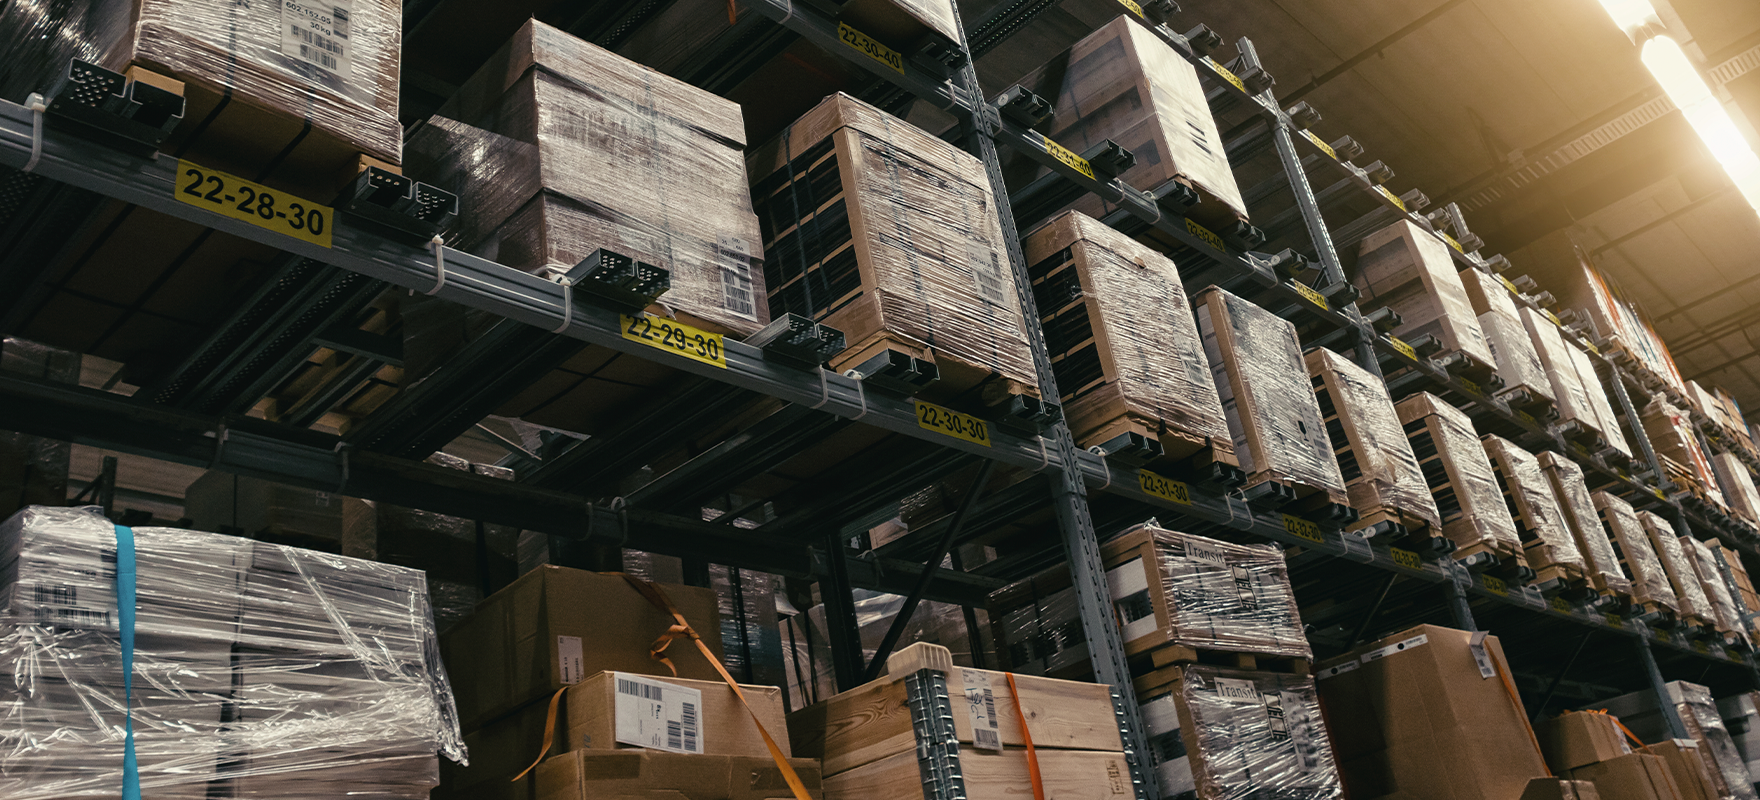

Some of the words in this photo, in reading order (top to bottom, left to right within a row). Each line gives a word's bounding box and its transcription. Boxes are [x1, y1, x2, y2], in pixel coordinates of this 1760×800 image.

[285, 1, 331, 25] 602.152.05
[840, 26, 900, 69] 22-30-40
[1046, 141, 1092, 176] 22-31-40
[183, 168, 324, 236] 22-28-30
[626, 314, 719, 361] 22-29-30
[919, 404, 986, 441] 22-30-30
[1140, 473, 1188, 502] 22-31-30
[1284, 517, 1321, 541] 22-32-30
[1185, 542, 1226, 563] Transit
[1216, 681, 1257, 700] Transit
